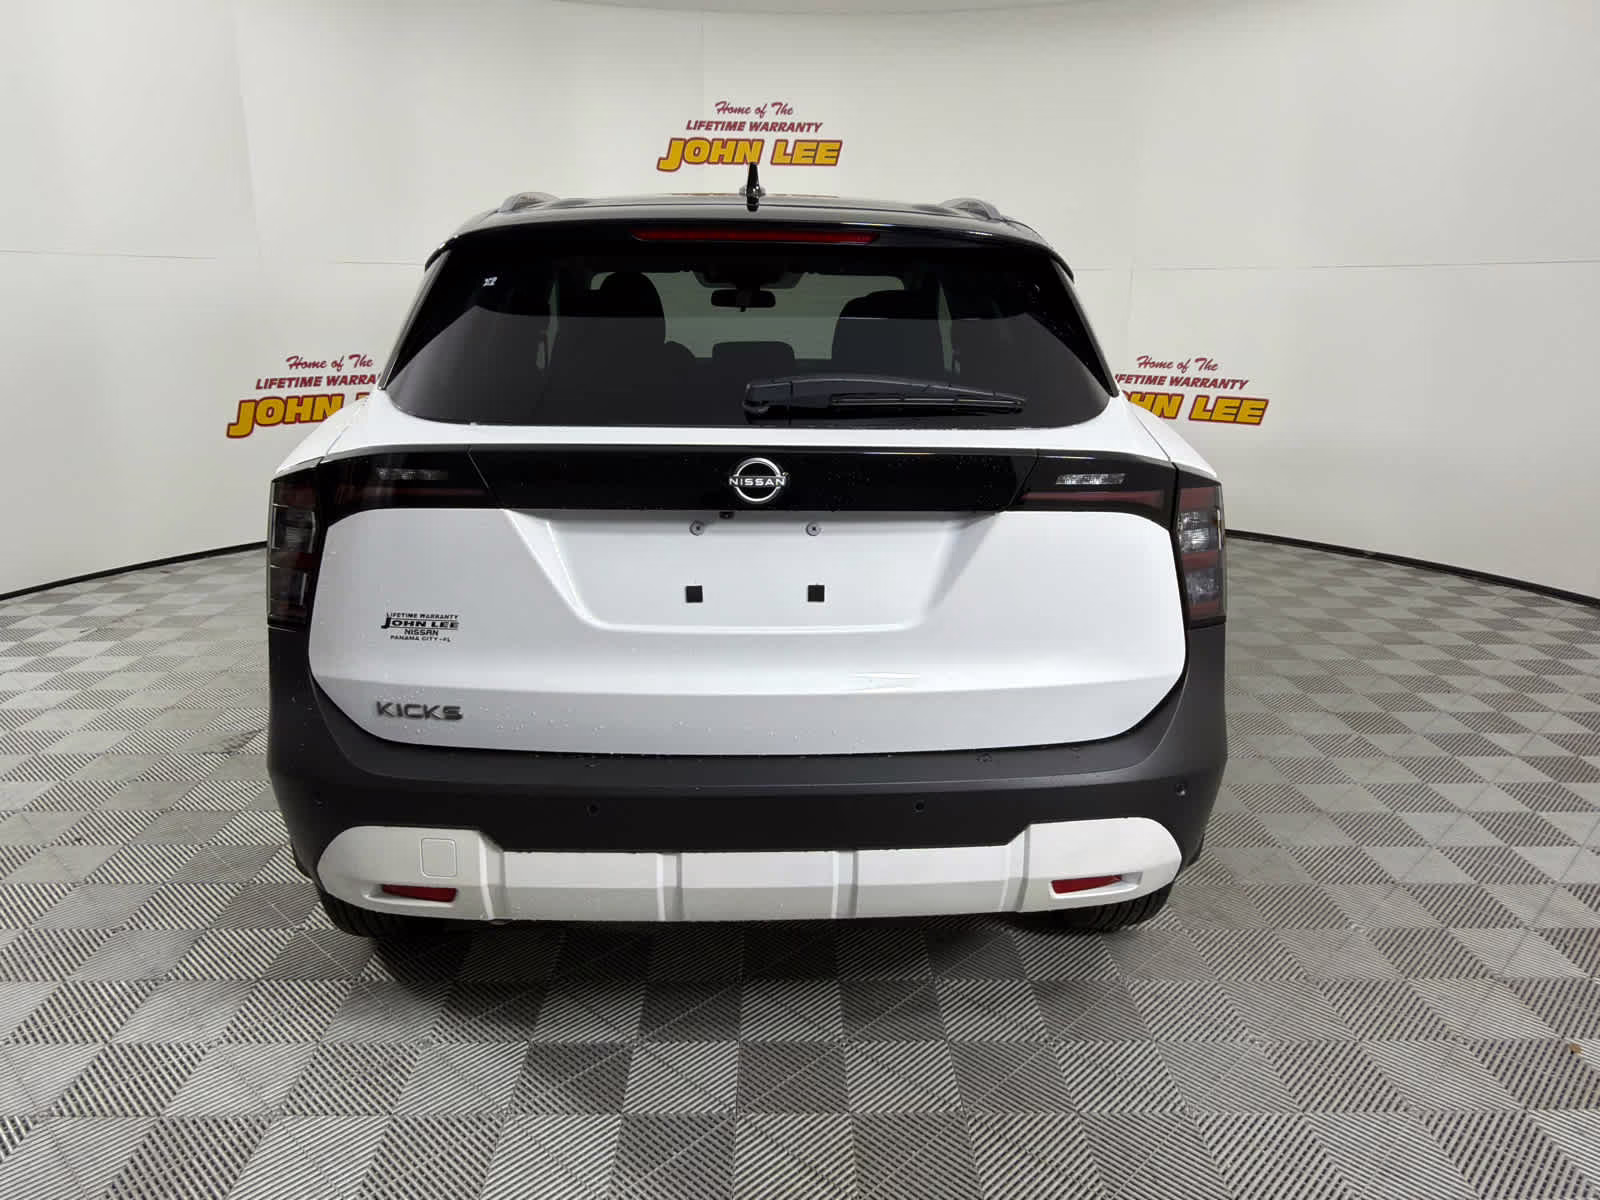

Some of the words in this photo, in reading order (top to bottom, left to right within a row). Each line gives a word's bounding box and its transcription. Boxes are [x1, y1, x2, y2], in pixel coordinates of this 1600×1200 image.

[715, 101, 751, 115] Home
[755, 103, 767, 118] of
[771, 102, 793, 116] The
[686, 120, 746, 131] LIFETIME
[749, 121, 823, 133] WARRANTY
[656, 137, 765, 172] JOHN
[770, 139, 843, 166] LEE
[286, 355, 327, 370] Home
[331, 356, 344, 371] of
[348, 354, 373, 369] The
[1136, 355, 1174, 369] Home
[1177, 358, 1191, 373] of
[1194, 357, 1219, 371] The
[256, 376, 323, 390] LIFETIME
[326, 374, 381, 387] WARRA
[1169, 376, 1249, 390] WARRANTY
[226, 393, 345, 438] JOHN
[1188, 395, 1270, 426] LEE
[728, 478, 785, 486] NISSAN
[381, 617, 427, 629] JOHN
[431, 620, 459, 629] LEE
[376, 701, 463, 721] KICKS
